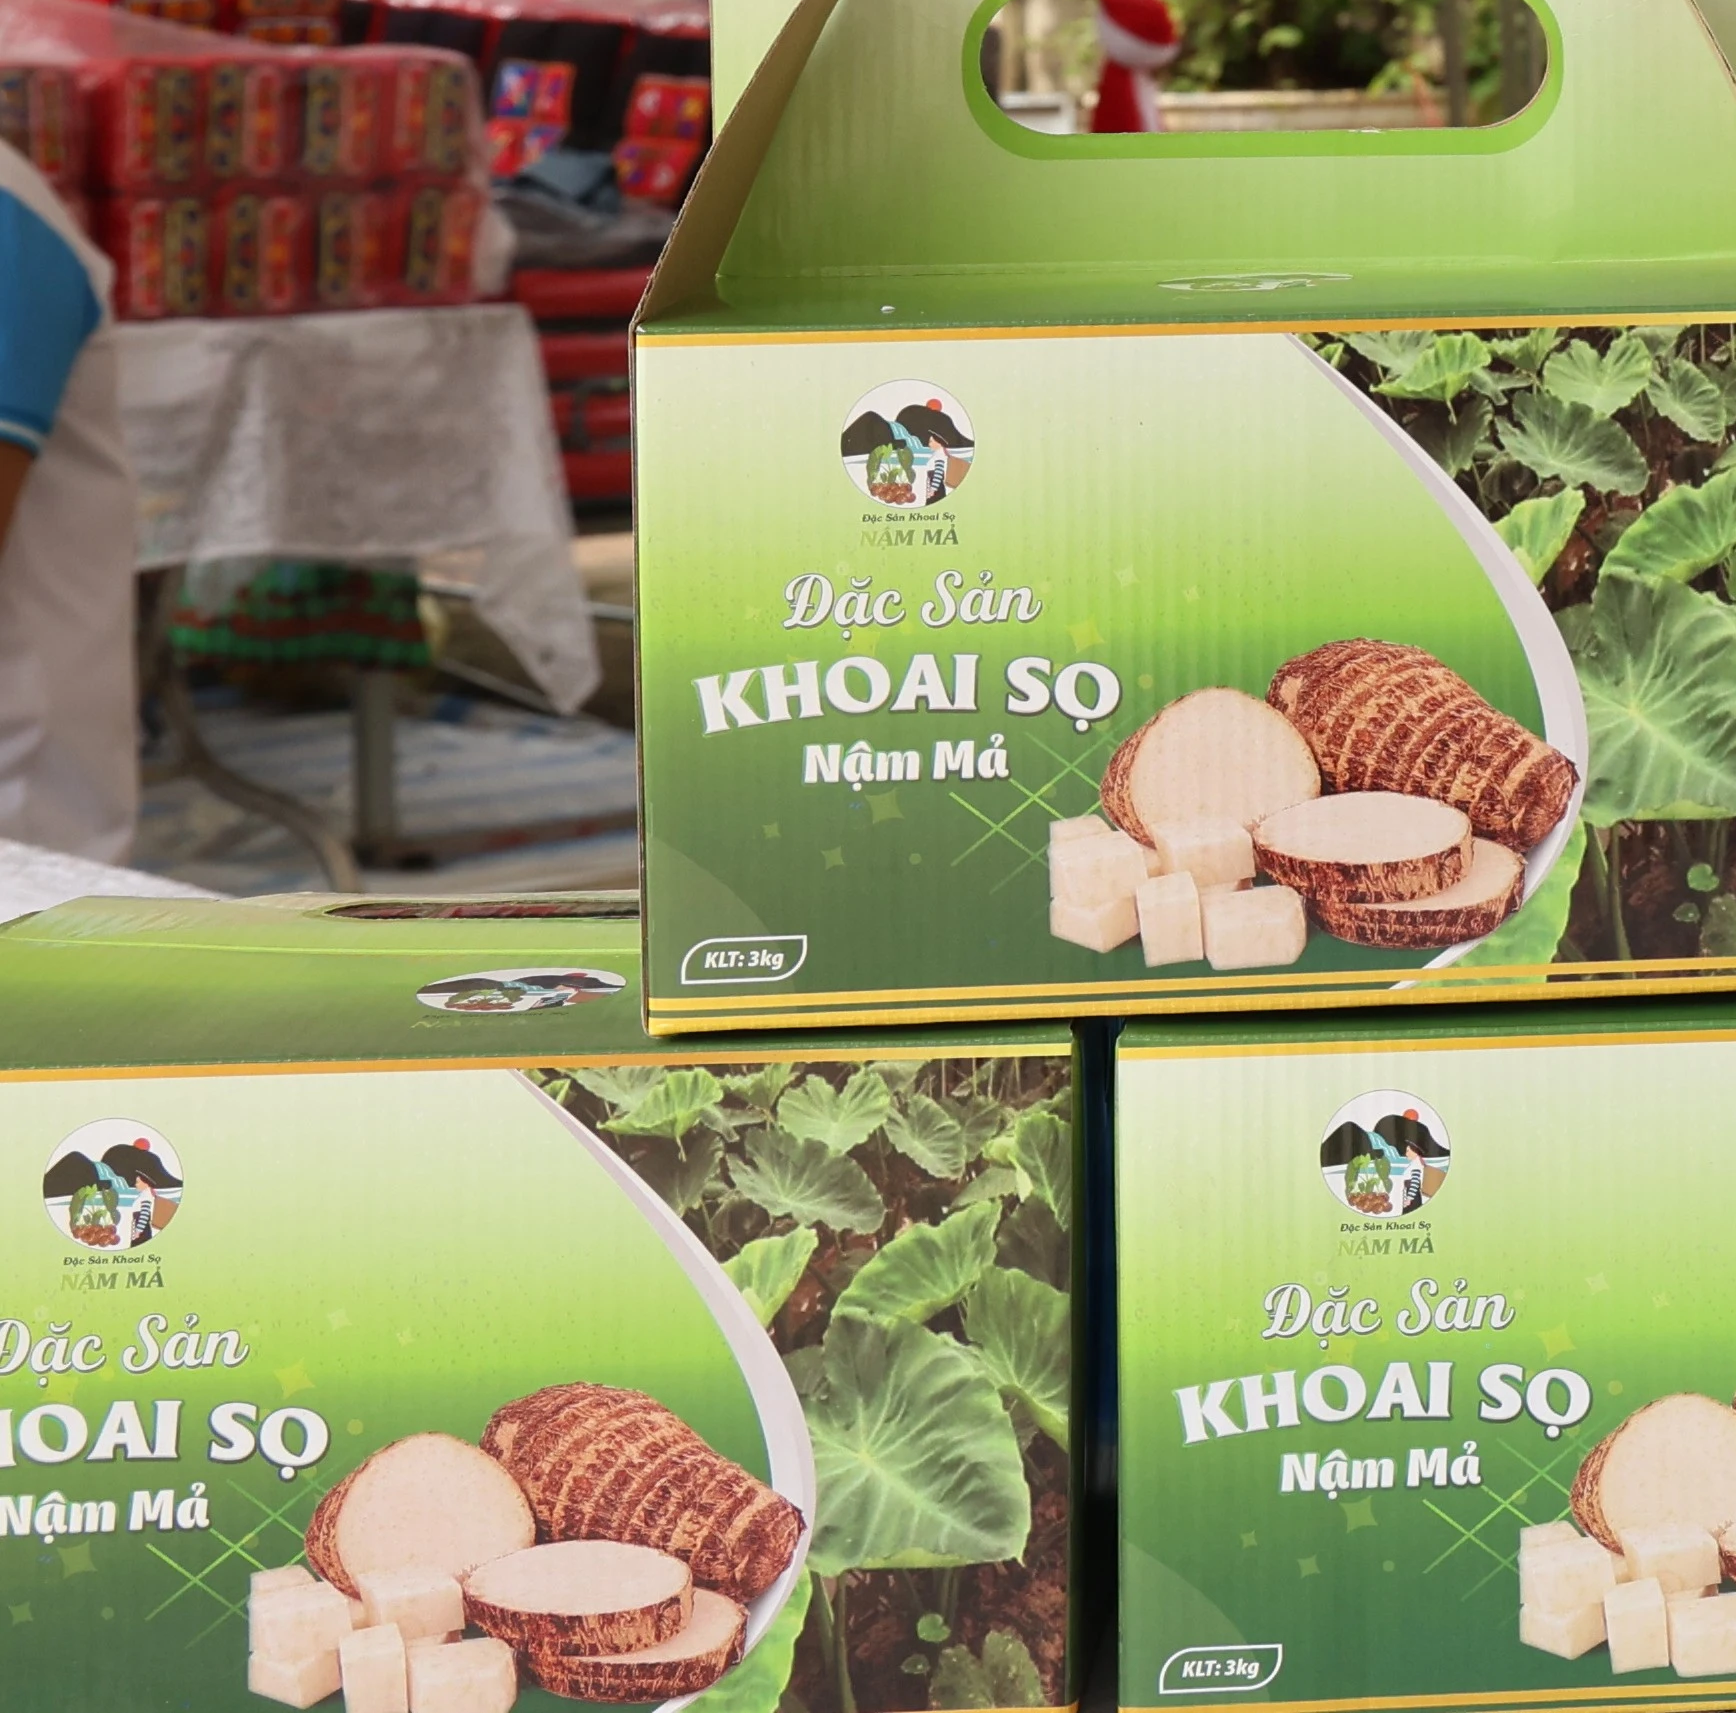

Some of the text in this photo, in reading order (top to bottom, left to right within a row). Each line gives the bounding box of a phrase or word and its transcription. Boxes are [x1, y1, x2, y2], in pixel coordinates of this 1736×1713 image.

[909, 512, 939, 521] Khoai
[922, 523, 959, 546] MẢ
[783, 568, 1042, 641] Đặc Sản
[693, 652, 1122, 739] KHOAI SỌ
[803, 732, 1010, 792] Nậm Mả
[704, 949, 785, 970] KLT: 3kg
[1385, 1221, 1415, 1231] Khoai
[1399, 1232, 1434, 1254] MẢ
[112, 1254, 143, 1264] Khoai
[125, 1266, 164, 1289] MẢ
[1261, 1278, 1516, 1349] Đặc Sản
[121, 1313, 249, 1374] Sản
[1173, 1361, 1594, 1446] KHOAI SỌ
[207, 1402, 331, 1482] SỌ
[1280, 1440, 1481, 1499] Nậm Mả
[0, 1481, 211, 1545] Nậm Mả
[1182, 1657, 1260, 1680] KLT: 3kg
